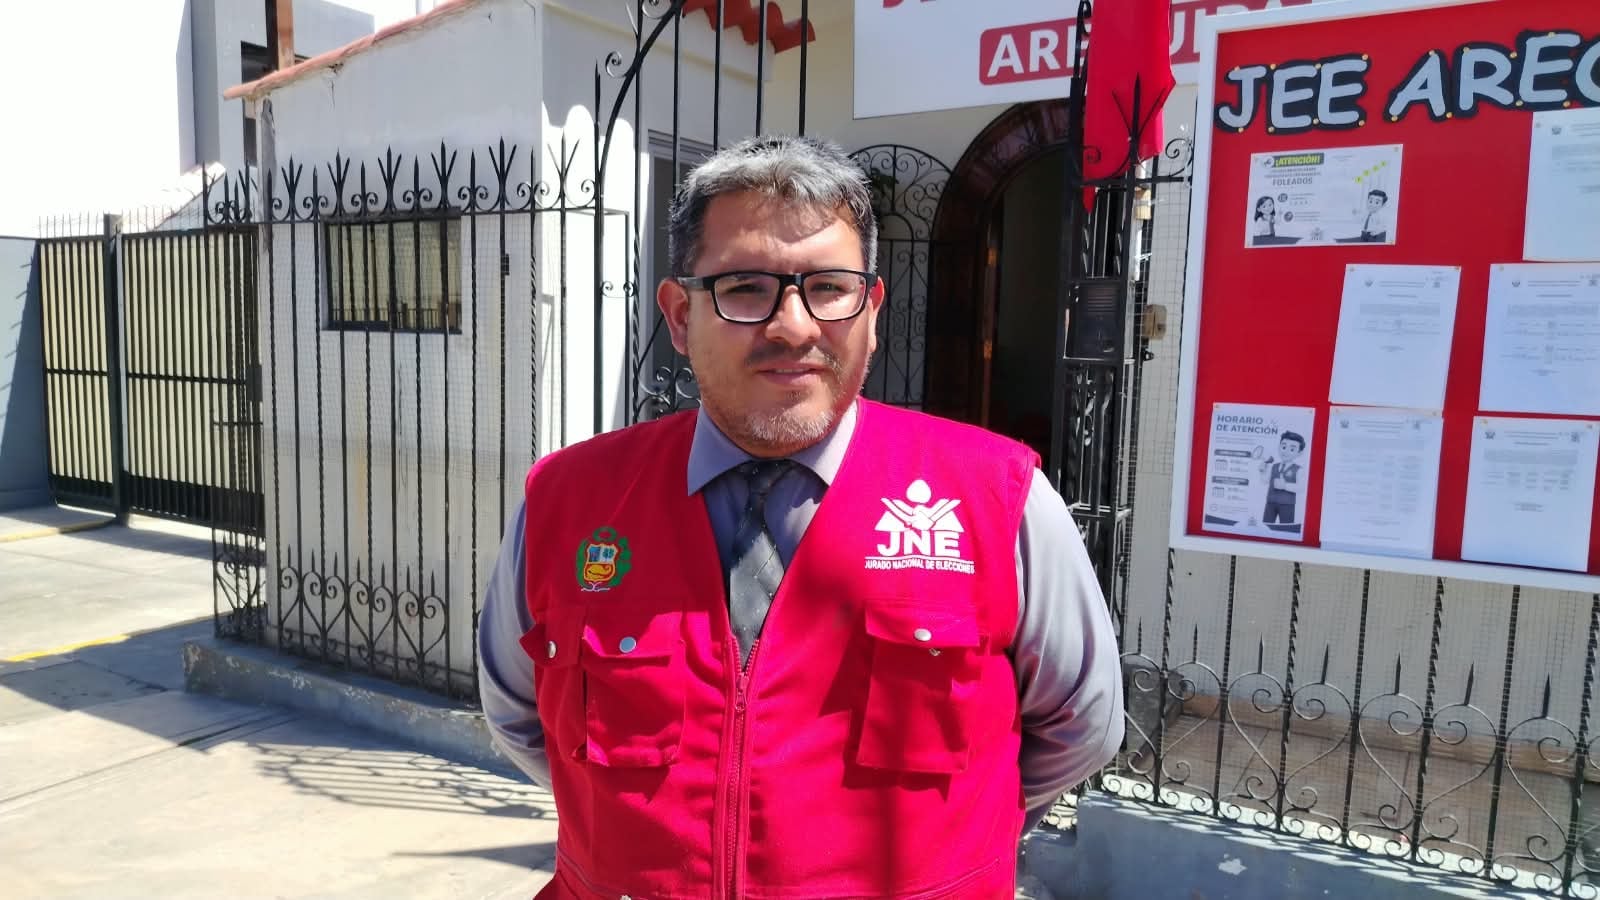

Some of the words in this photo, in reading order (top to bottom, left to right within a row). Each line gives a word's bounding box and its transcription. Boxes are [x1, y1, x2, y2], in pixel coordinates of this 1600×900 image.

[1215, 56, 1369, 131] JEE
[1273, 177, 1313, 186] FOLEADOS
[1217, 415, 1263, 425] HORARIO
[1216, 424, 1228, 432] DE
[1231, 425, 1278, 435] ATENCIÓN
[877, 530, 961, 557] JNE
[864, 559, 892, 570] JURADO
[892, 558, 924, 570] NACIONAL
[925, 560, 935, 570] DE
[935, 560, 975, 575] ELECCIONES
